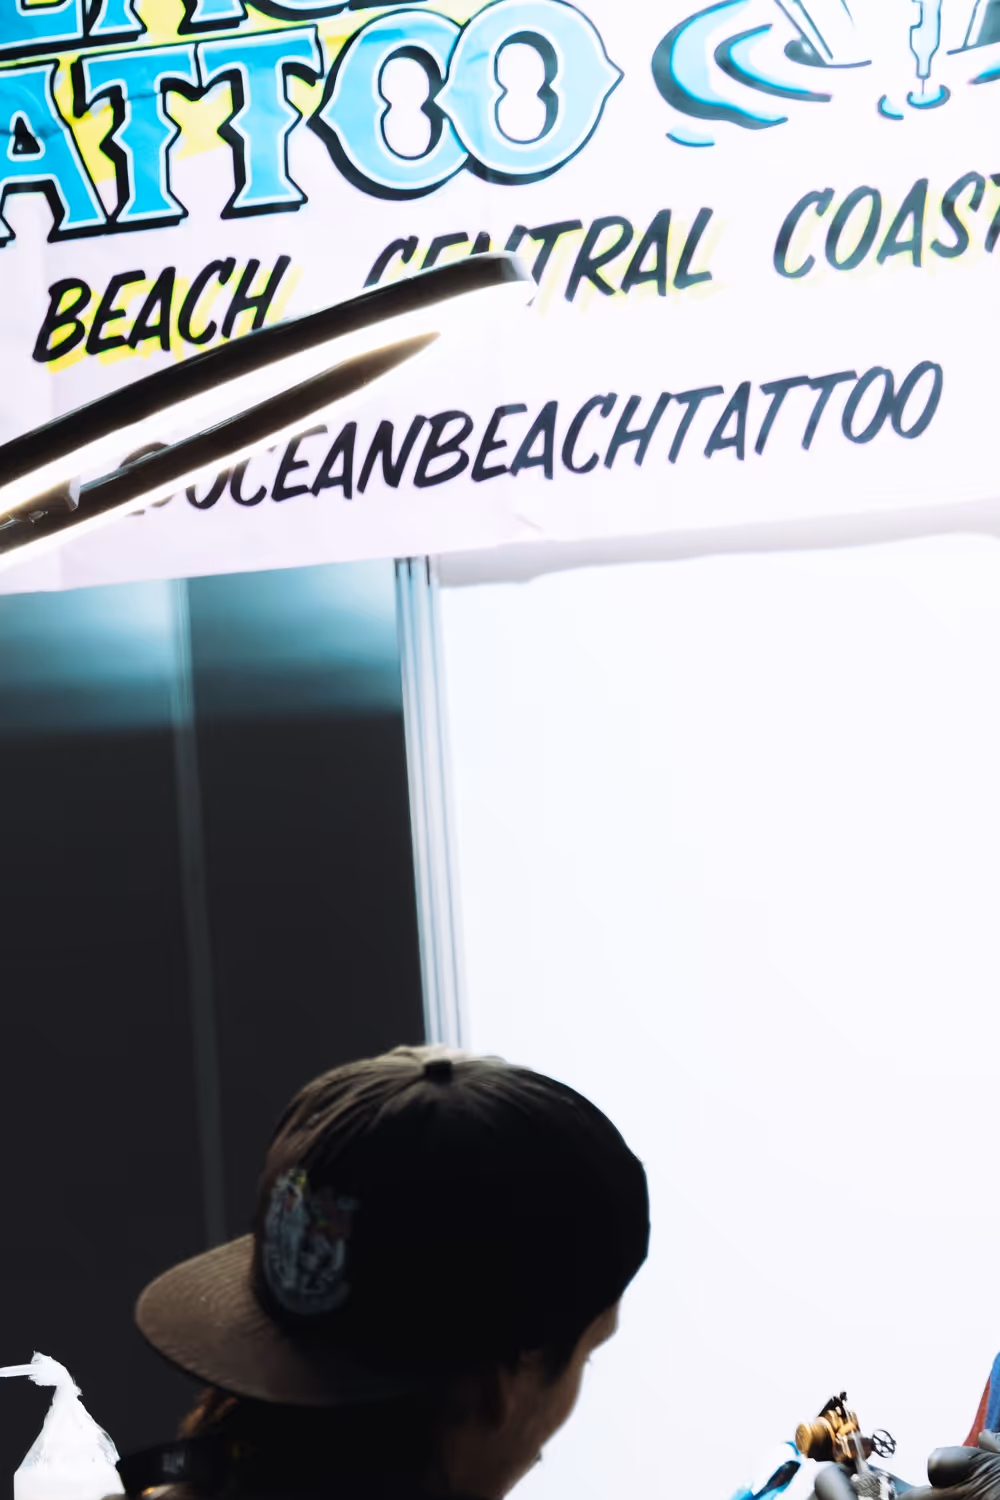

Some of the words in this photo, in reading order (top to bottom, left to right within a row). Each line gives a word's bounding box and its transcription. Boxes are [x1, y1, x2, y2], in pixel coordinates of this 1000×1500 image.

[32, 255, 291, 363] BEACH
[363, 208, 713, 306] CTRAL
[116, 360, 943, 516] CEANBEACHTATTOO
